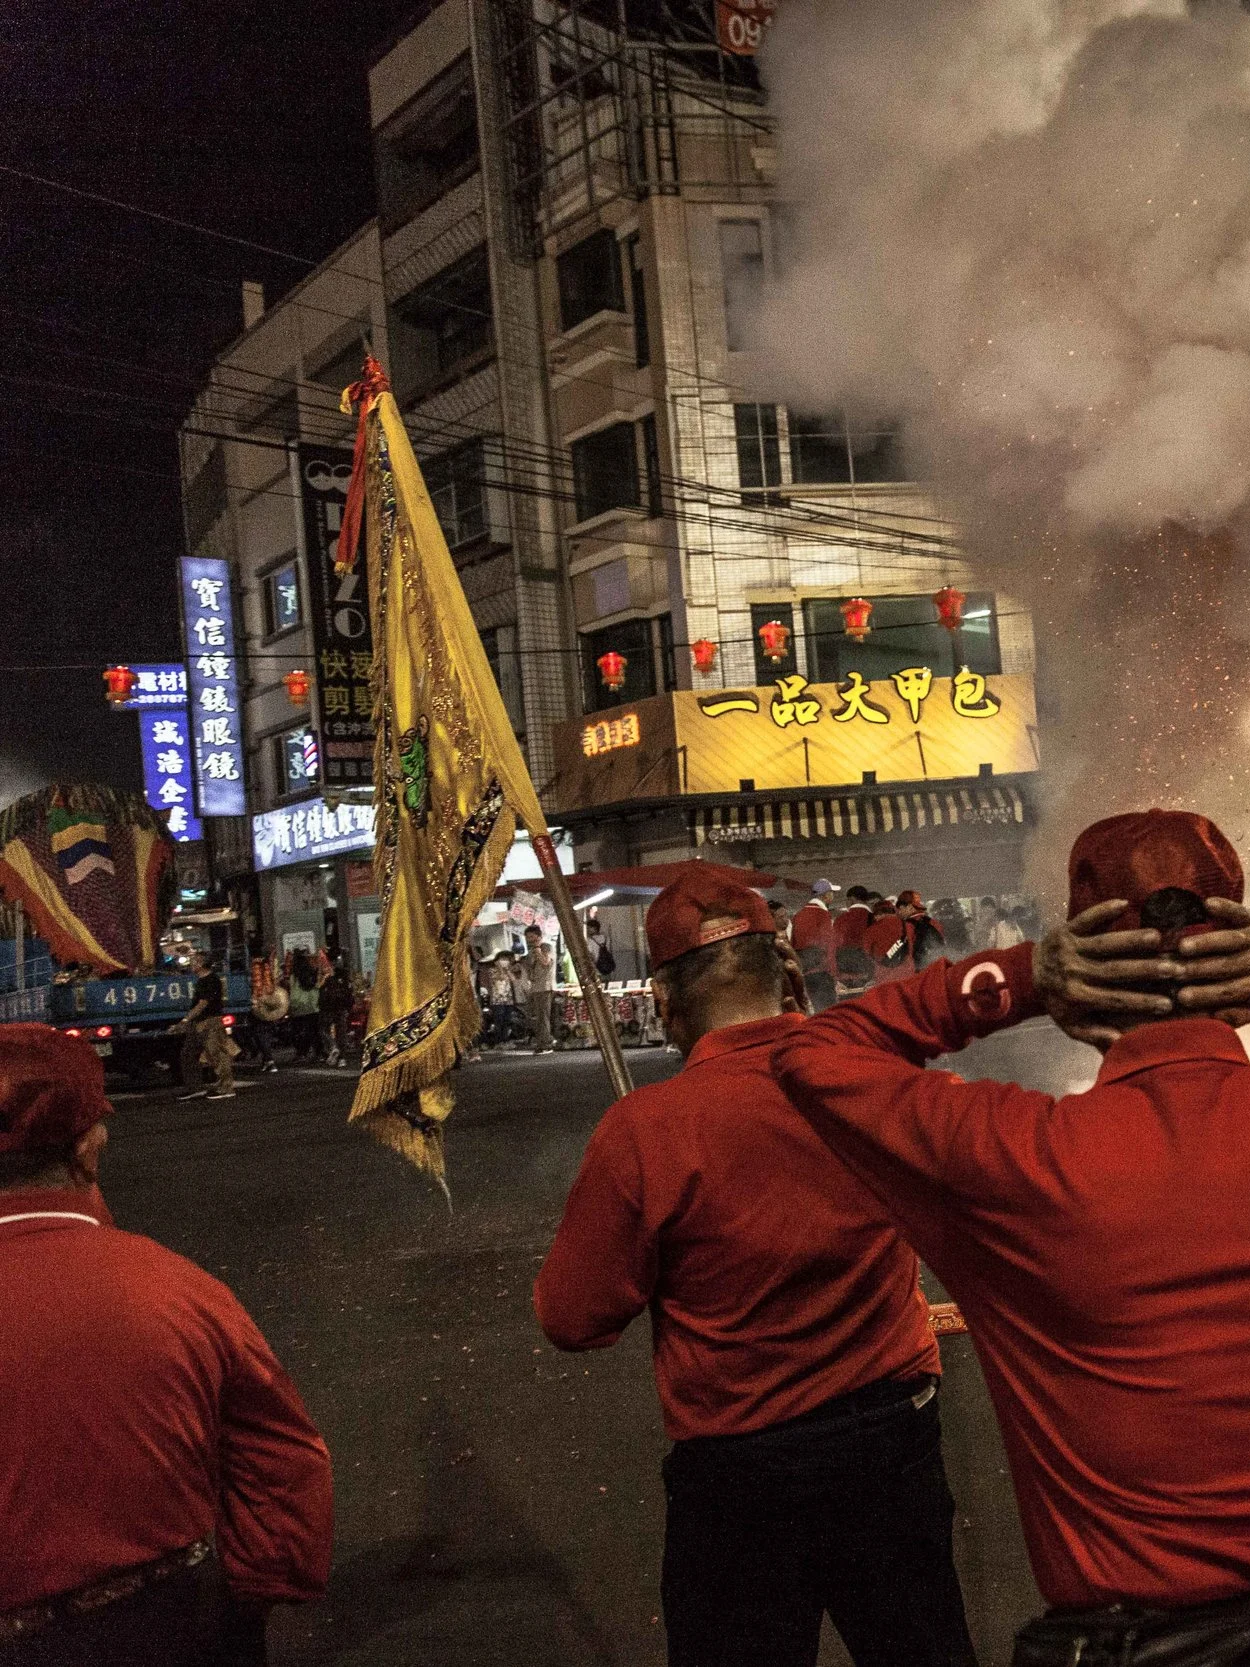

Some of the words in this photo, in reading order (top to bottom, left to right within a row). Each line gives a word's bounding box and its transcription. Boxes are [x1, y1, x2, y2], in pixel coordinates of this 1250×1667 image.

[192, 577, 240, 781] 寶信鐘錶眼鏡
[701, 667, 1000, 727] 一品大甲包
